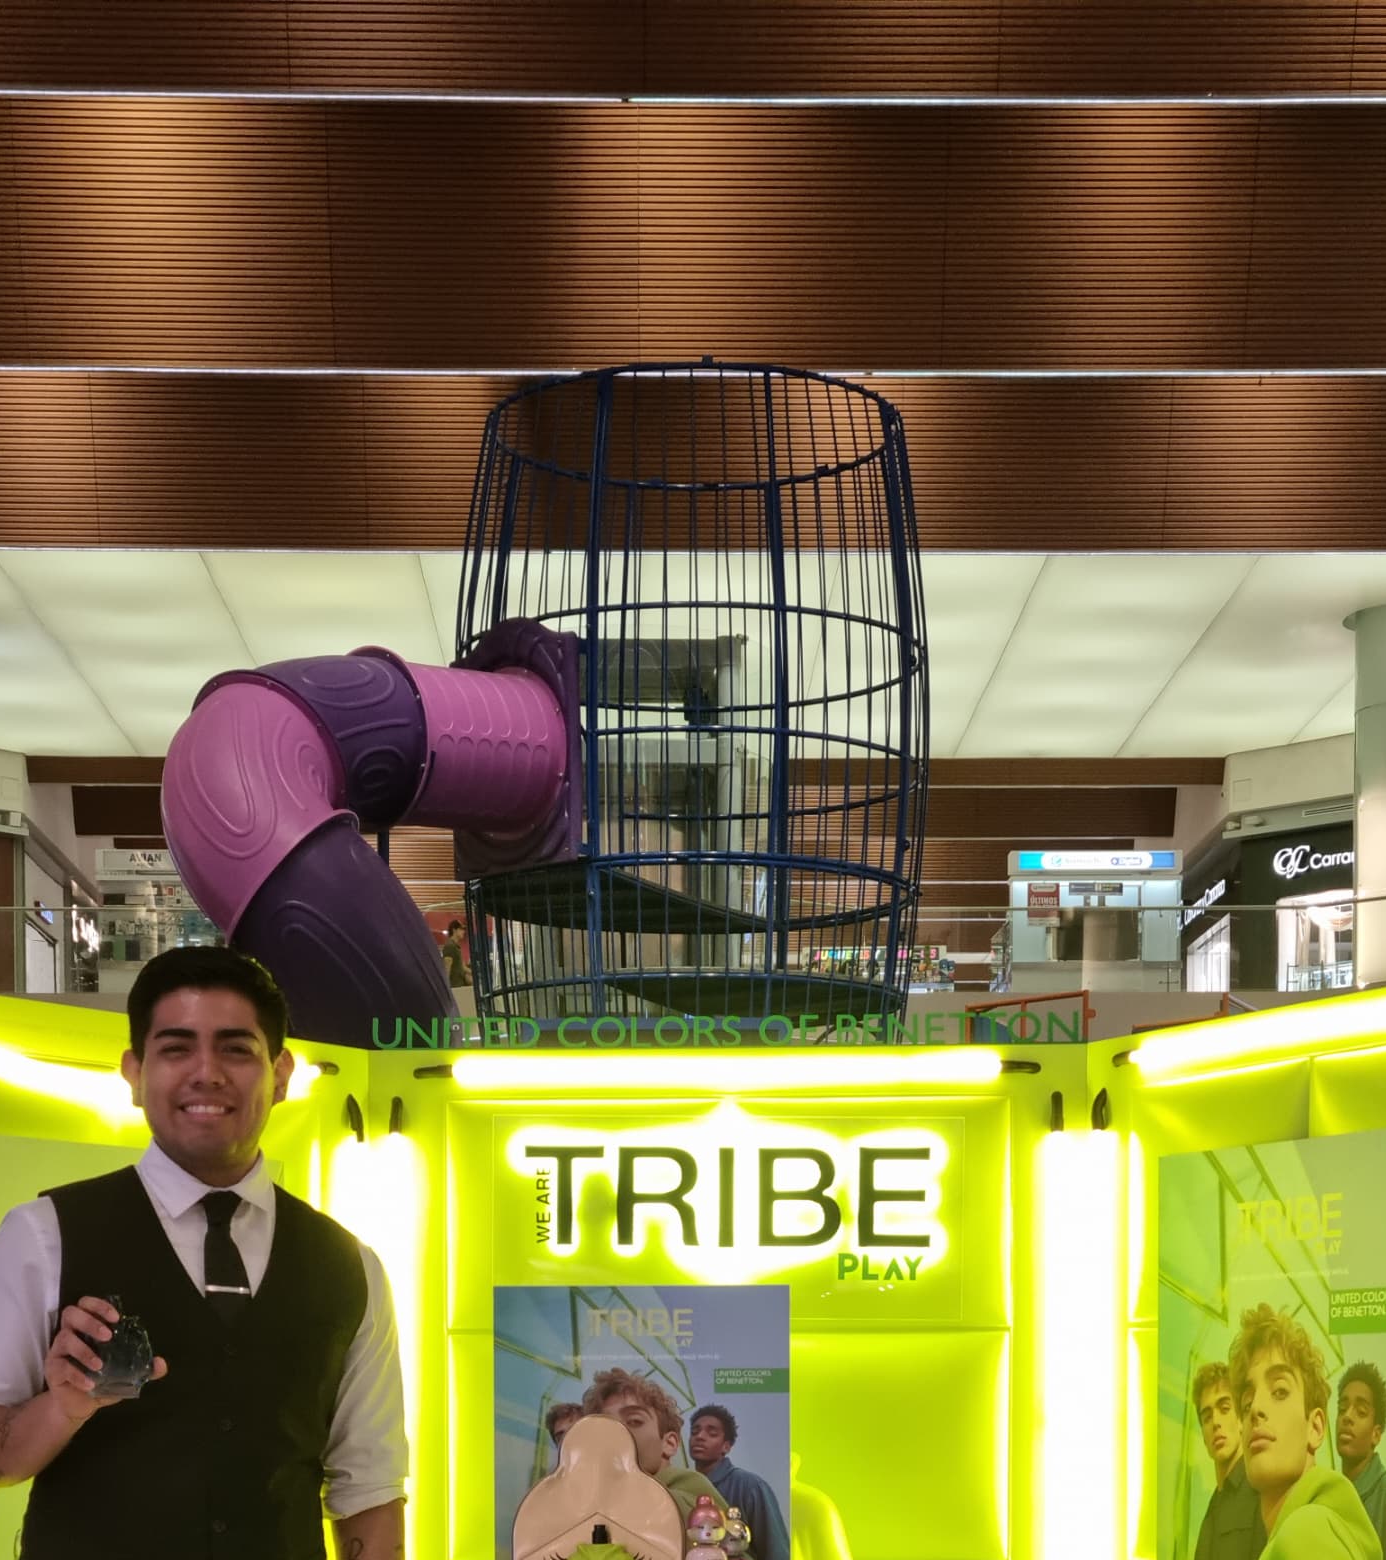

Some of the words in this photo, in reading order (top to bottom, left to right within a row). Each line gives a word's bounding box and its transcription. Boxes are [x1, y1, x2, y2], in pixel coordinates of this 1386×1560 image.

[372, 1017, 541, 1049] UNITED
[557, 1016, 741, 1048] COLORS
[759, 1014, 818, 1047] OF
[836, 1011, 1084, 1046] BENETTON
[525, 1146, 930, 1248] TRIBE
[536, 1167, 551, 1206] ARE
[536, 1212, 551, 1244] WE
[1237, 1192, 1343, 1244] TRIBE
[837, 1252, 923, 1281] PLAY
[1331, 1292, 1362, 1305] UNITED
[1331, 1306, 1342, 1318] OF
[589, 1308, 693, 1337] TRIBE
